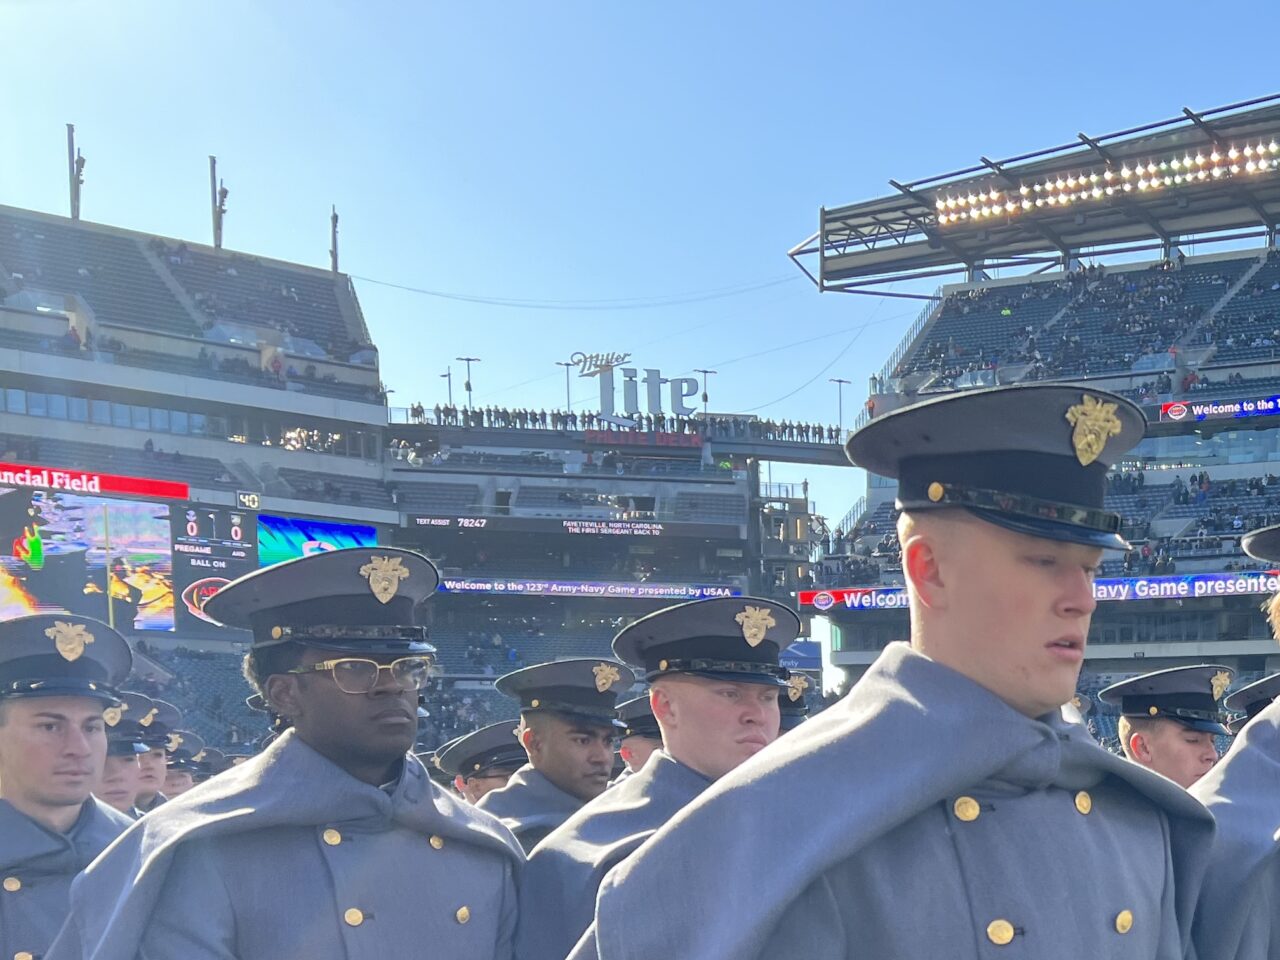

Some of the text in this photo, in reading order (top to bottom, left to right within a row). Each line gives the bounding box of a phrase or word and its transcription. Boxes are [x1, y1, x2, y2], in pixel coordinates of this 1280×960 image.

[571, 352, 632, 376] Miller
[1192, 403, 1240, 416] Welcome
[1243, 402, 1255, 411] to
[1257, 399, 1274, 410] the
[0, 470, 100, 493] ncial Field
[240, 494, 258, 508] 40
[186, 522, 198, 536] 0
[457, 518, 487, 528] 78247
[231, 526, 241, 540] 0
[174, 544, 211, 554] PREGAME
[190, 559, 211, 568] BALL
[444, 580, 491, 591] Welcome
[494, 582, 505, 590] to
[507, 582, 523, 591] the
[551, 584, 605, 594] Army-Navy
[608, 585, 635, 594] Game
[638, 586, 686, 596] presented
[688, 587, 700, 597] by
[703, 588, 730, 597] USAA
[1092, 576, 1278, 600] avy Game presente
[844, 591, 910, 608] Welcom
